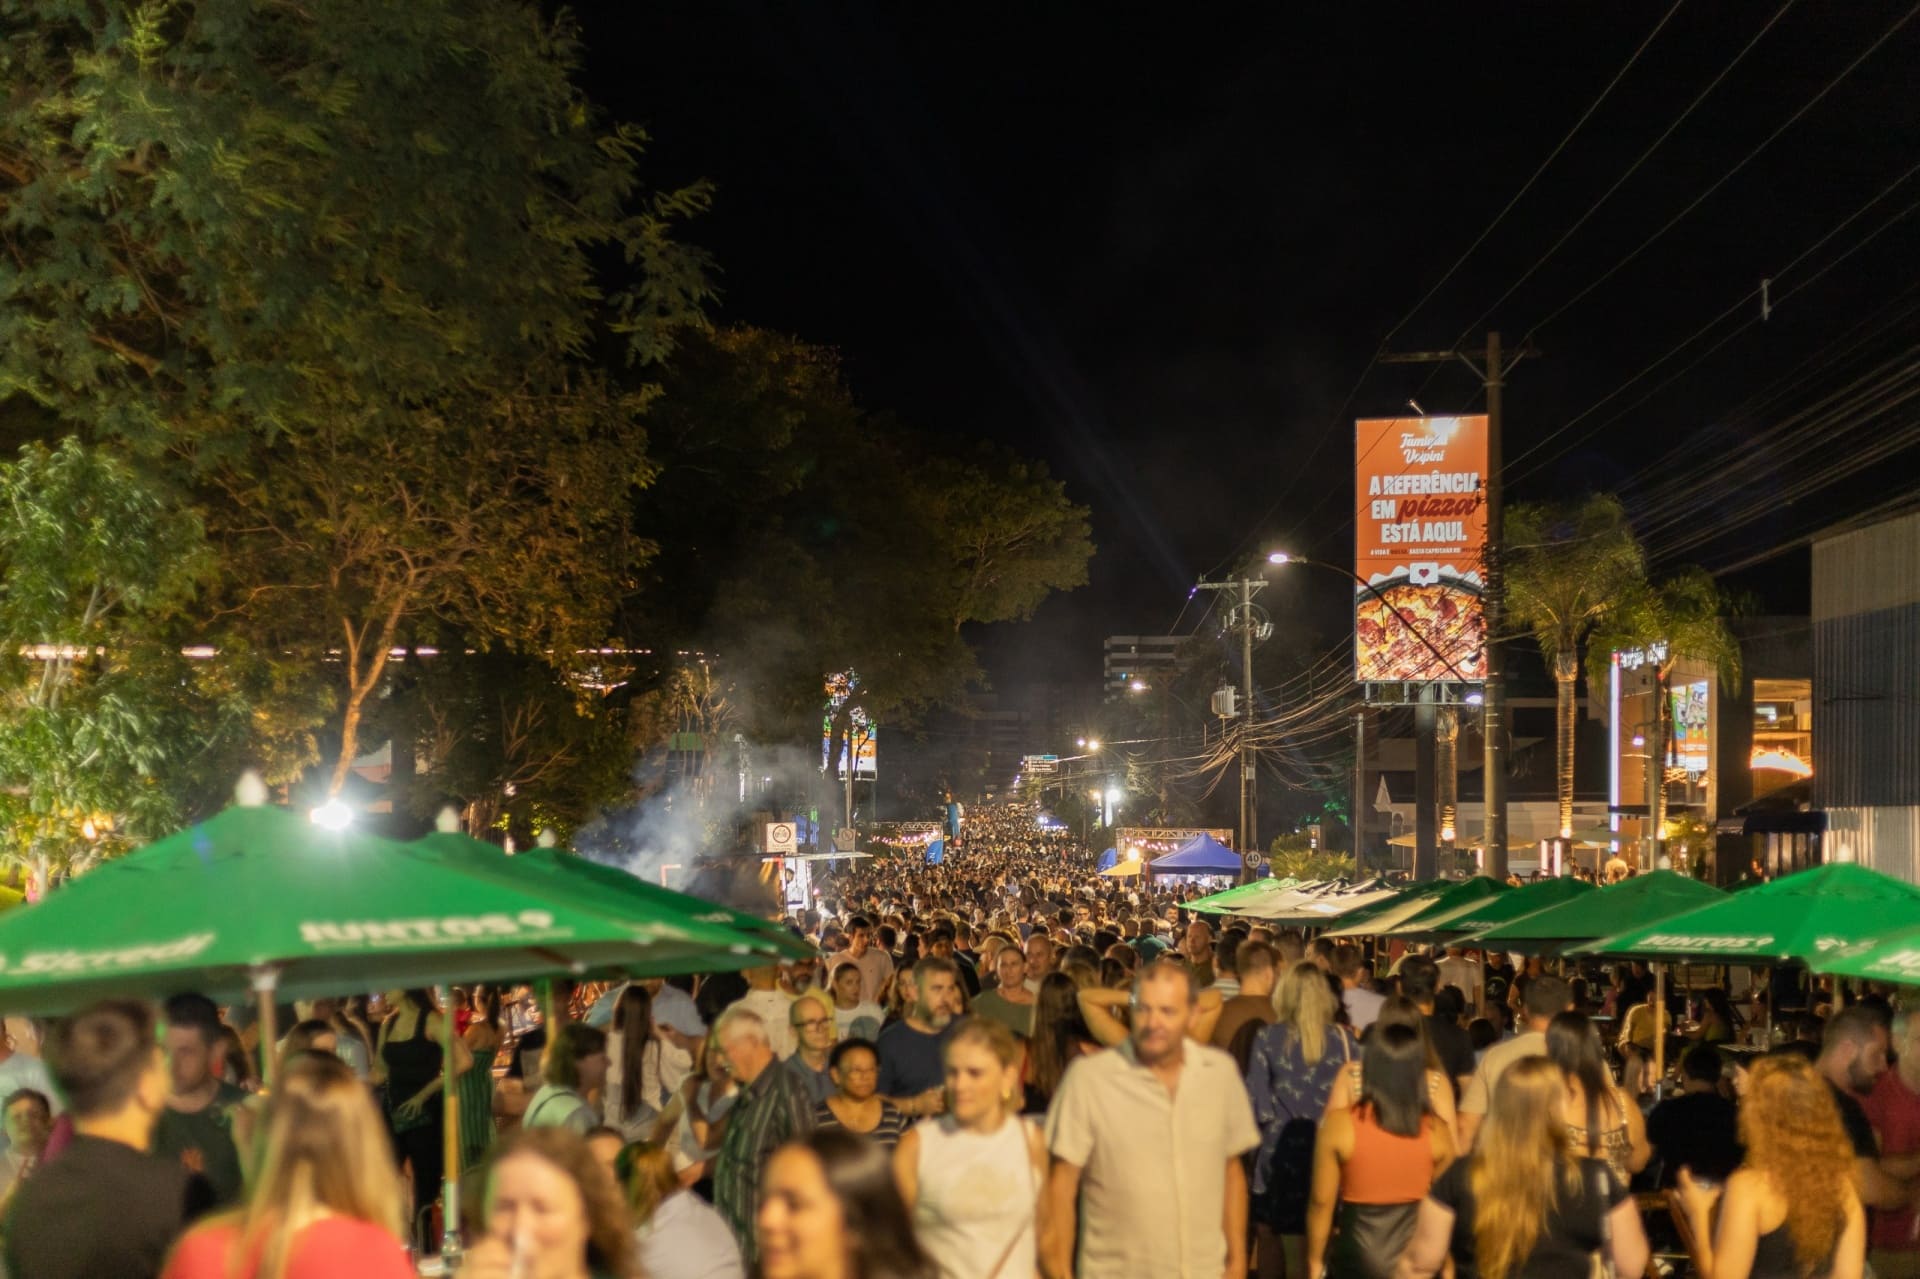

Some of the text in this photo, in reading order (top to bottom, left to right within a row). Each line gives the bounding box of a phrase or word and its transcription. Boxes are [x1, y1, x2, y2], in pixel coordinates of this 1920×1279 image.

[1369, 470, 1480, 495] A REFERÊNCIA
[1371, 494, 1479, 525] EM pizza
[1381, 519, 1468, 543] ESTÁ AQUI.
[1638, 935, 1755, 947] JUNTOS
